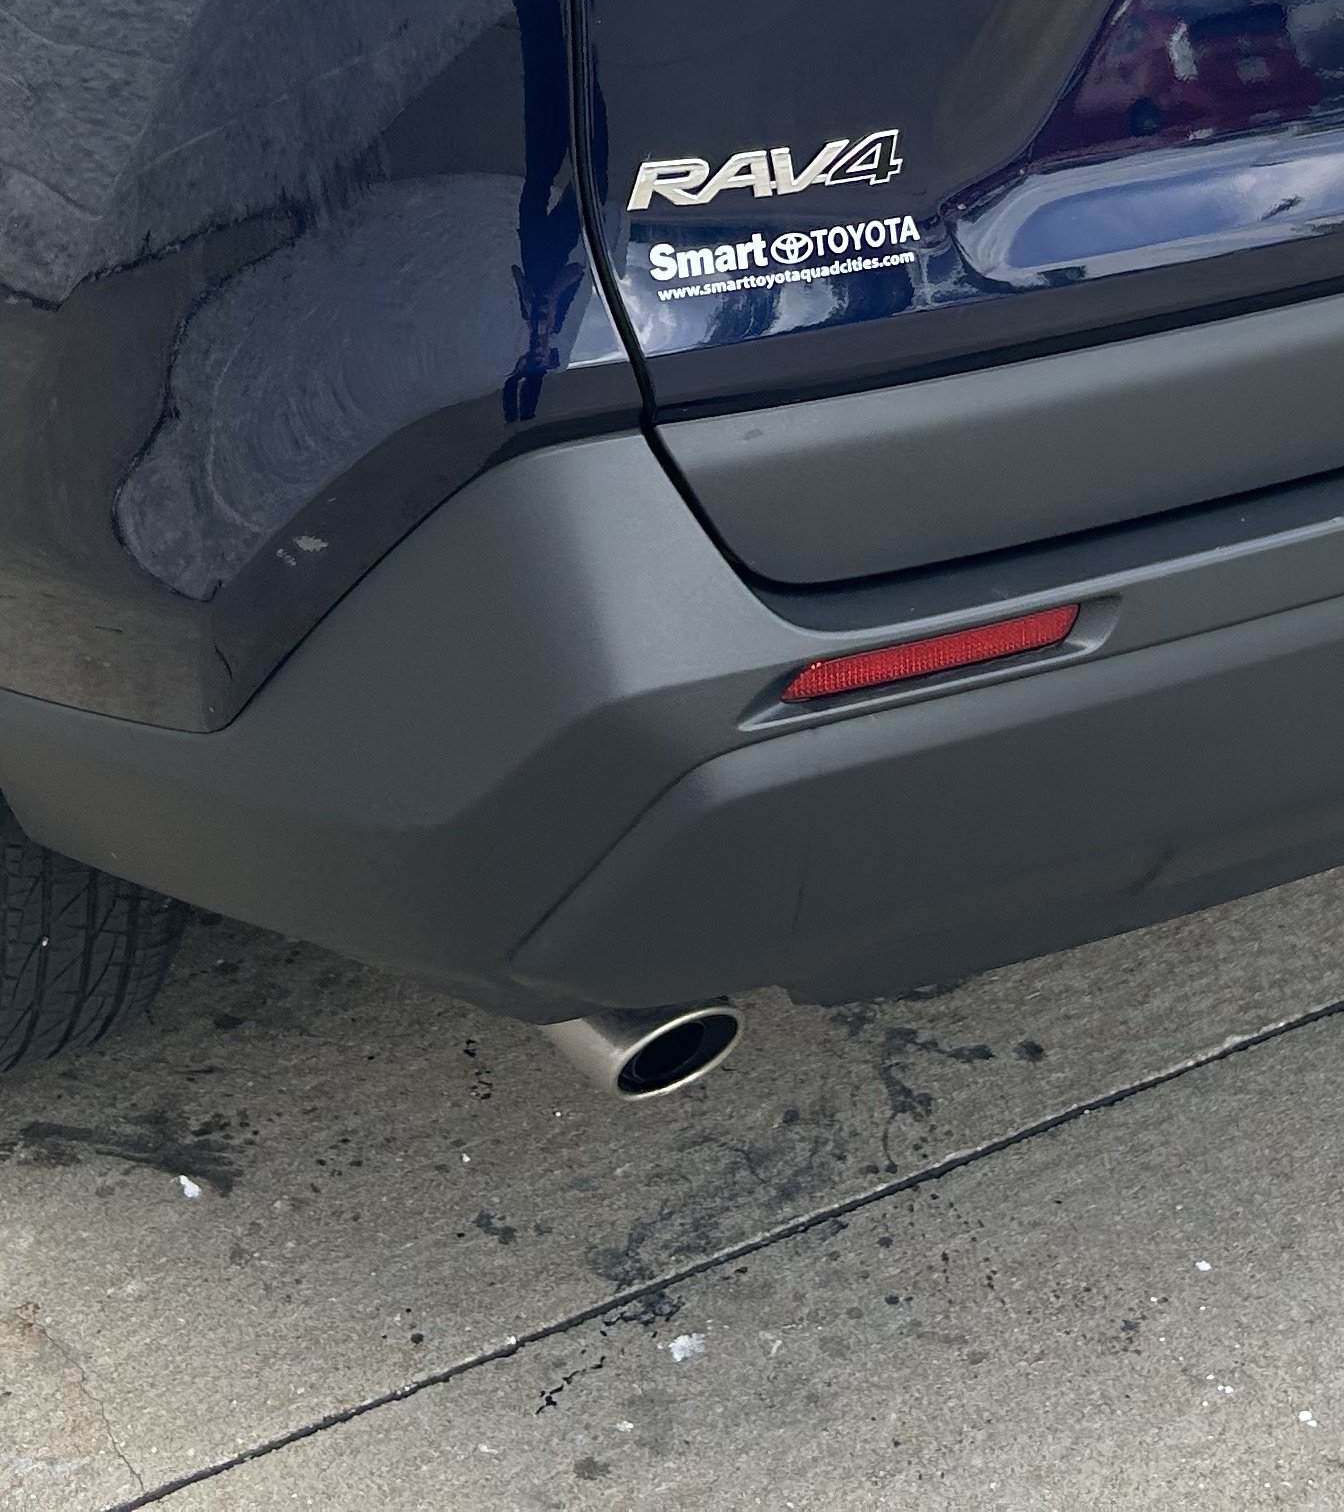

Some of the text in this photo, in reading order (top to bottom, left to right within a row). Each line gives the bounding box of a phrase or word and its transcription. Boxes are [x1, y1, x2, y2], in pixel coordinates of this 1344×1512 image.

[627, 129, 903, 211] RAV4
[649, 215, 920, 281] Smart TOYOTA
[657, 251, 915, 301] www.smarttoyotaquadcities.com
